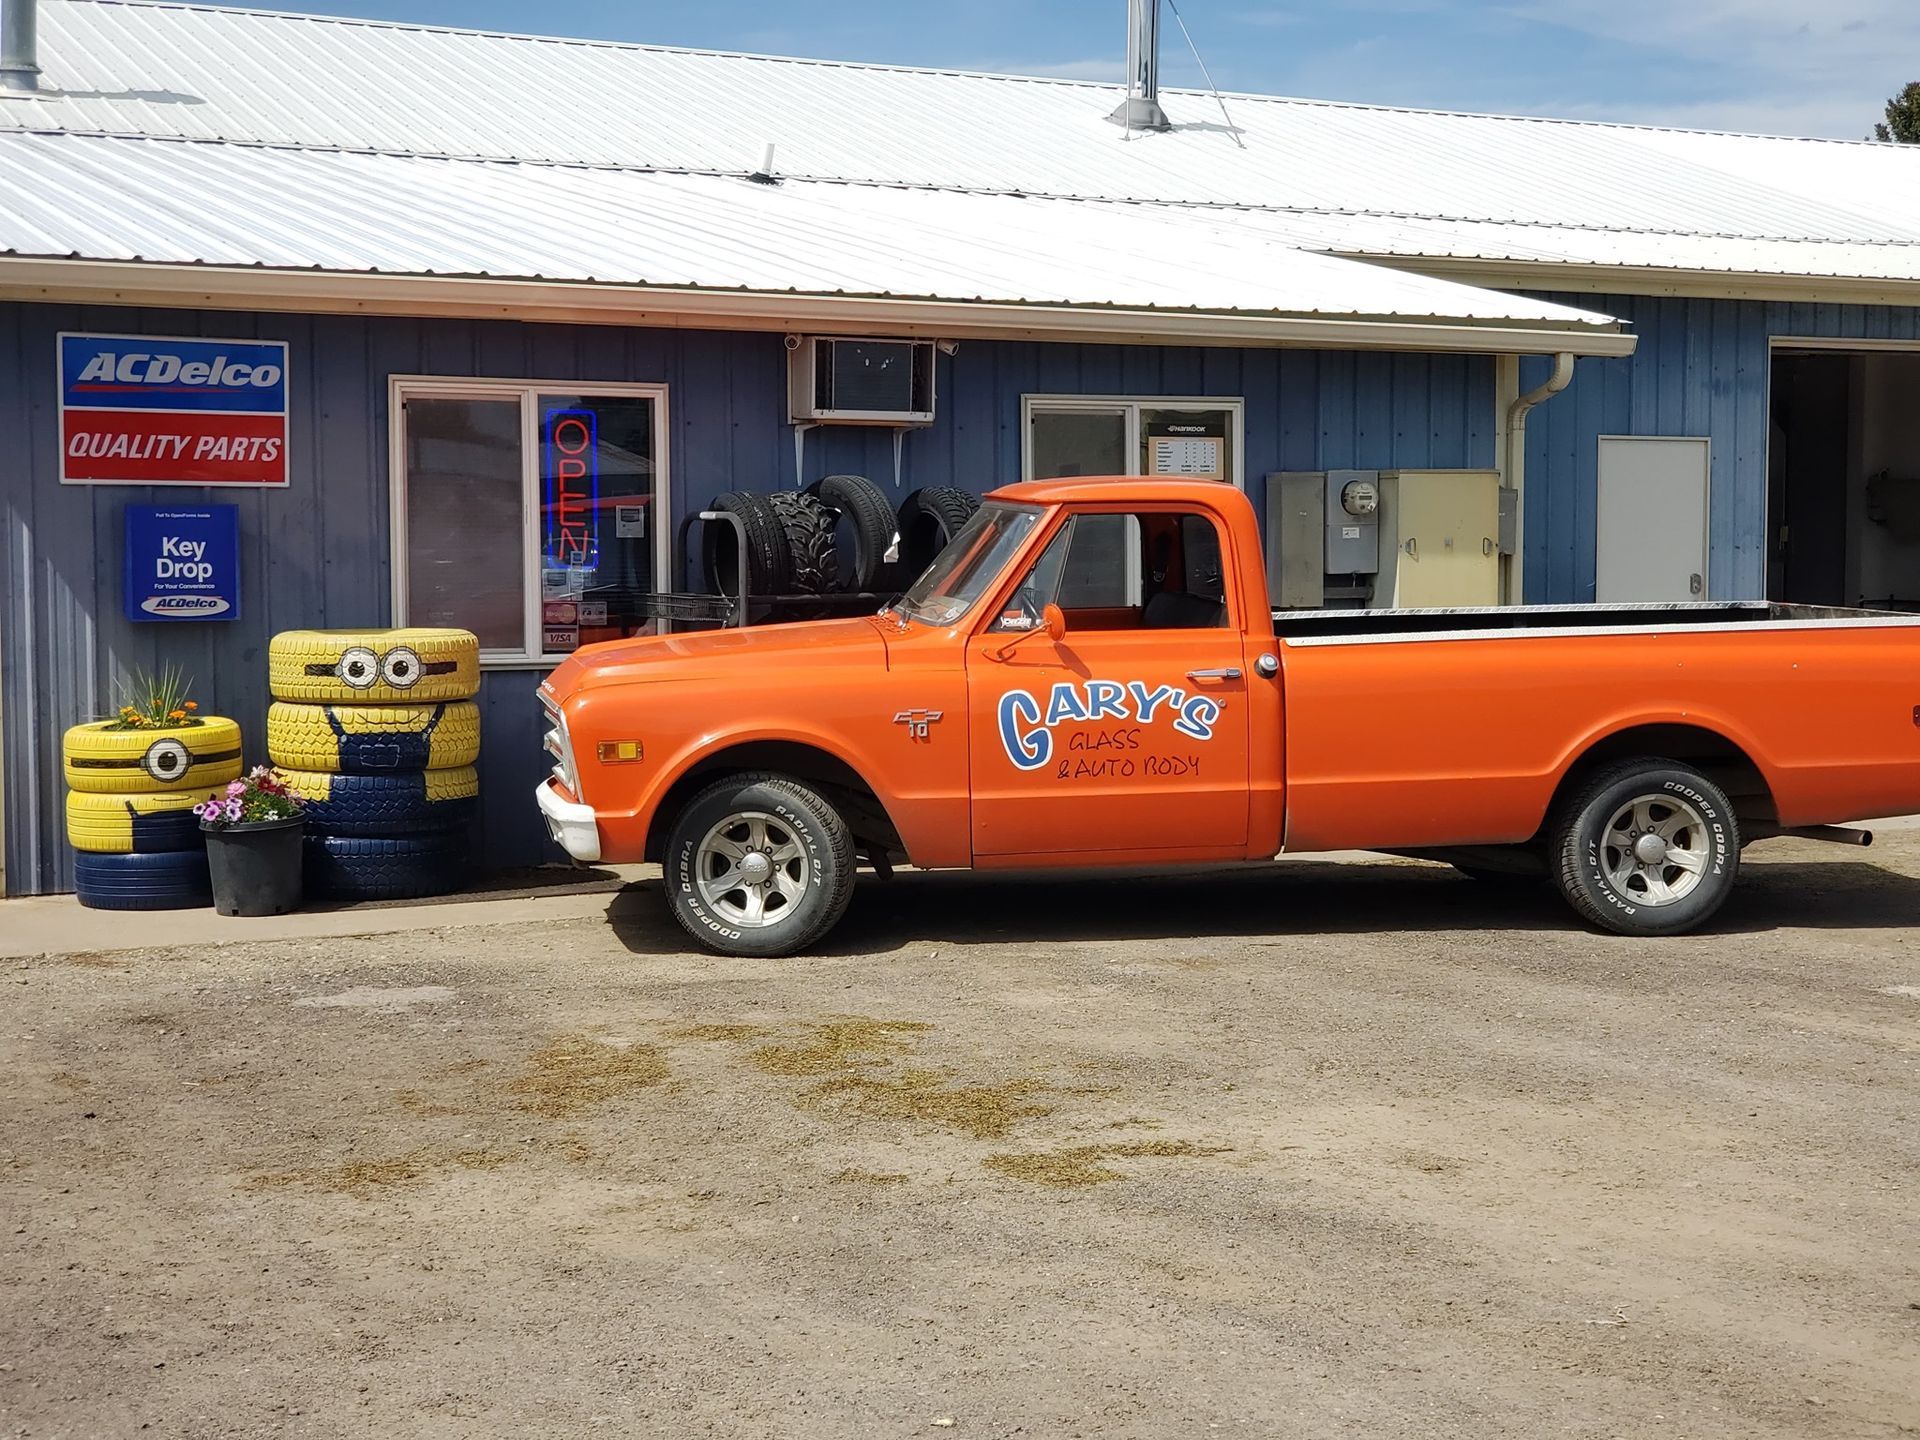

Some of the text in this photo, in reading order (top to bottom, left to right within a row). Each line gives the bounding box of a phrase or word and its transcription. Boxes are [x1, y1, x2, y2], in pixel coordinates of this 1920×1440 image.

[78, 352, 281, 388] ACDelco
[68, 432, 281, 462] QUALITY PARTS
[554, 419, 589, 561] OPEN
[162, 536, 206, 561] Key
[156, 558, 213, 582] Drop
[156, 598, 218, 608] ACDelco
[550, 633, 571, 642] VISA
[997, 680, 1221, 772] GARY'S
[1069, 728, 1141, 751] GLASS
[1057, 755, 1200, 779] & AUTO BODY
[1663, 781, 1726, 875] COOPER COBRA
[775, 805, 822, 887] RADIAL G/T
[679, 840, 741, 940] COOPER COBRA
[1589, 840, 1636, 915] RADIAL G/T
